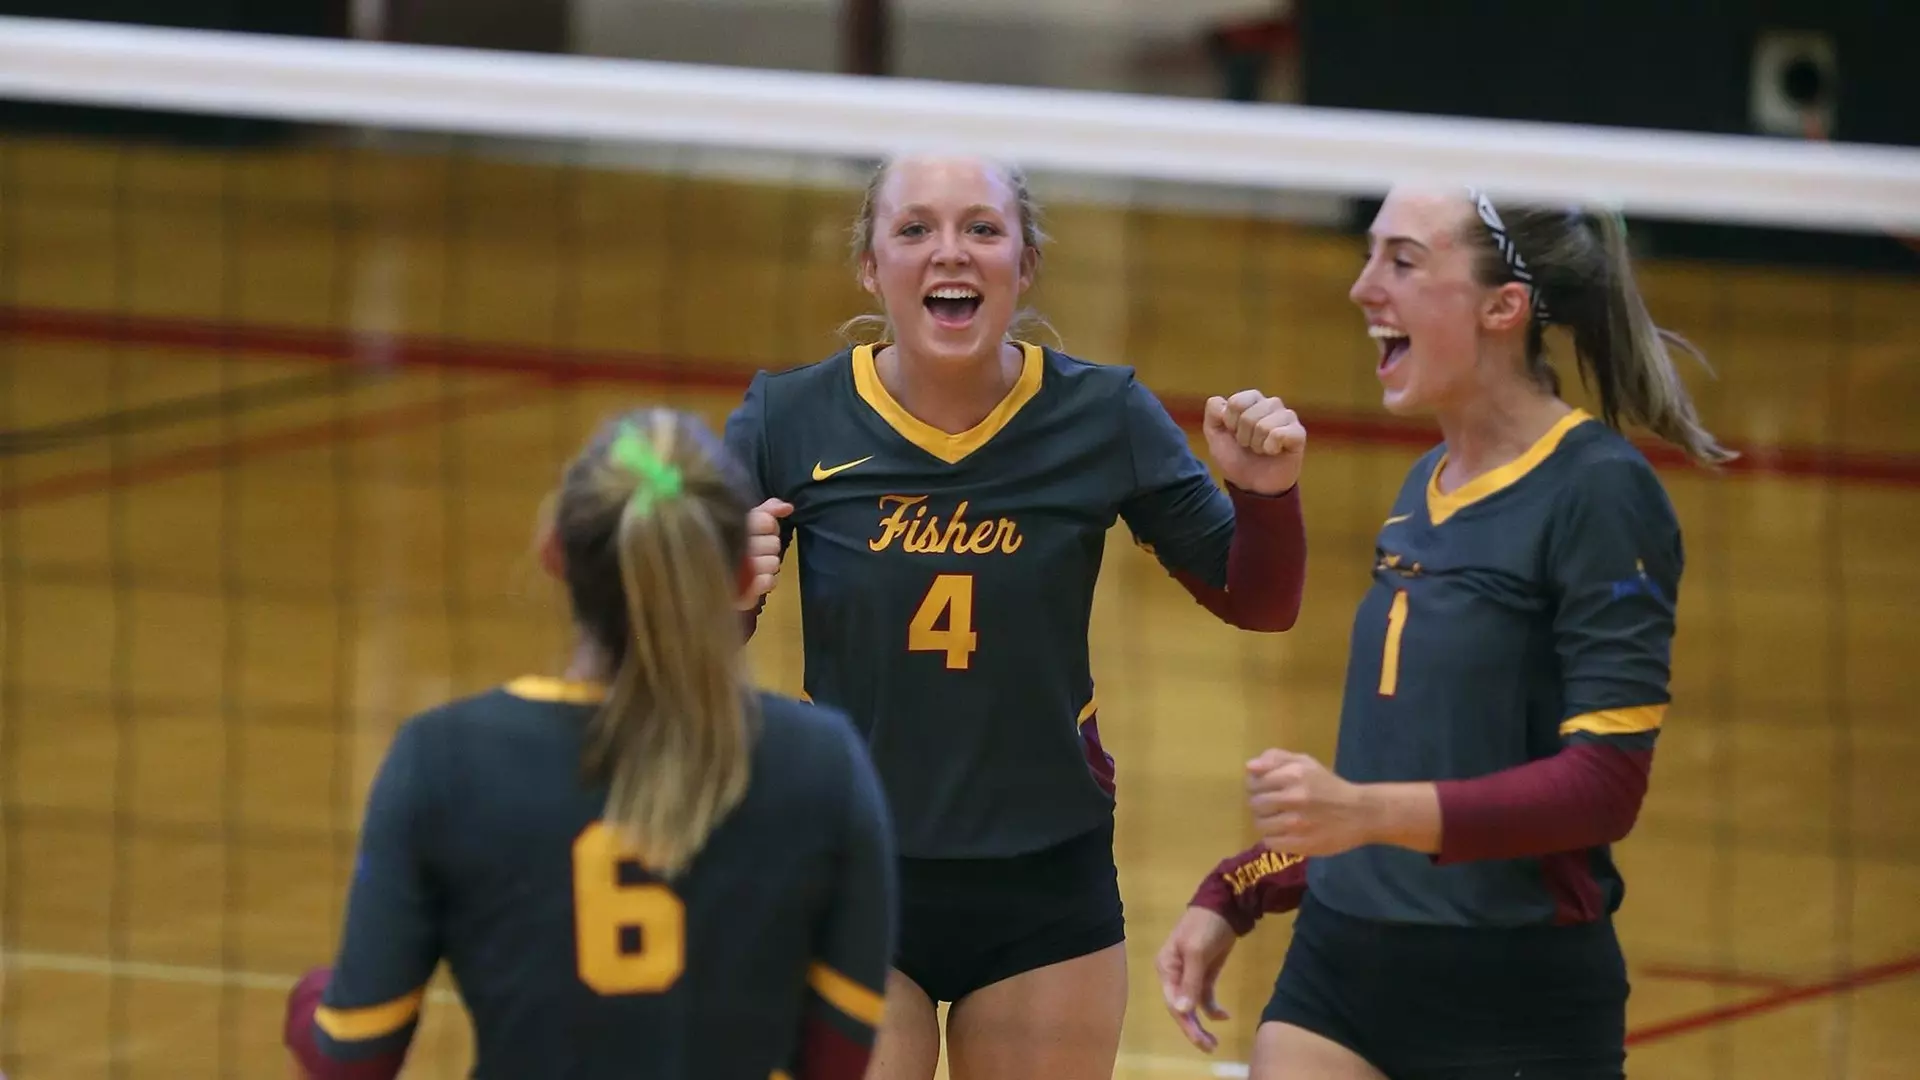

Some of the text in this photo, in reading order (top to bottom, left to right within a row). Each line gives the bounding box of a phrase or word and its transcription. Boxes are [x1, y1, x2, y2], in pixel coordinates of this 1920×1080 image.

[868, 494, 1023, 554] Fisher
[908, 573, 978, 669] 4
[1378, 589, 1408, 697] 1
[571, 821, 686, 996] 6
